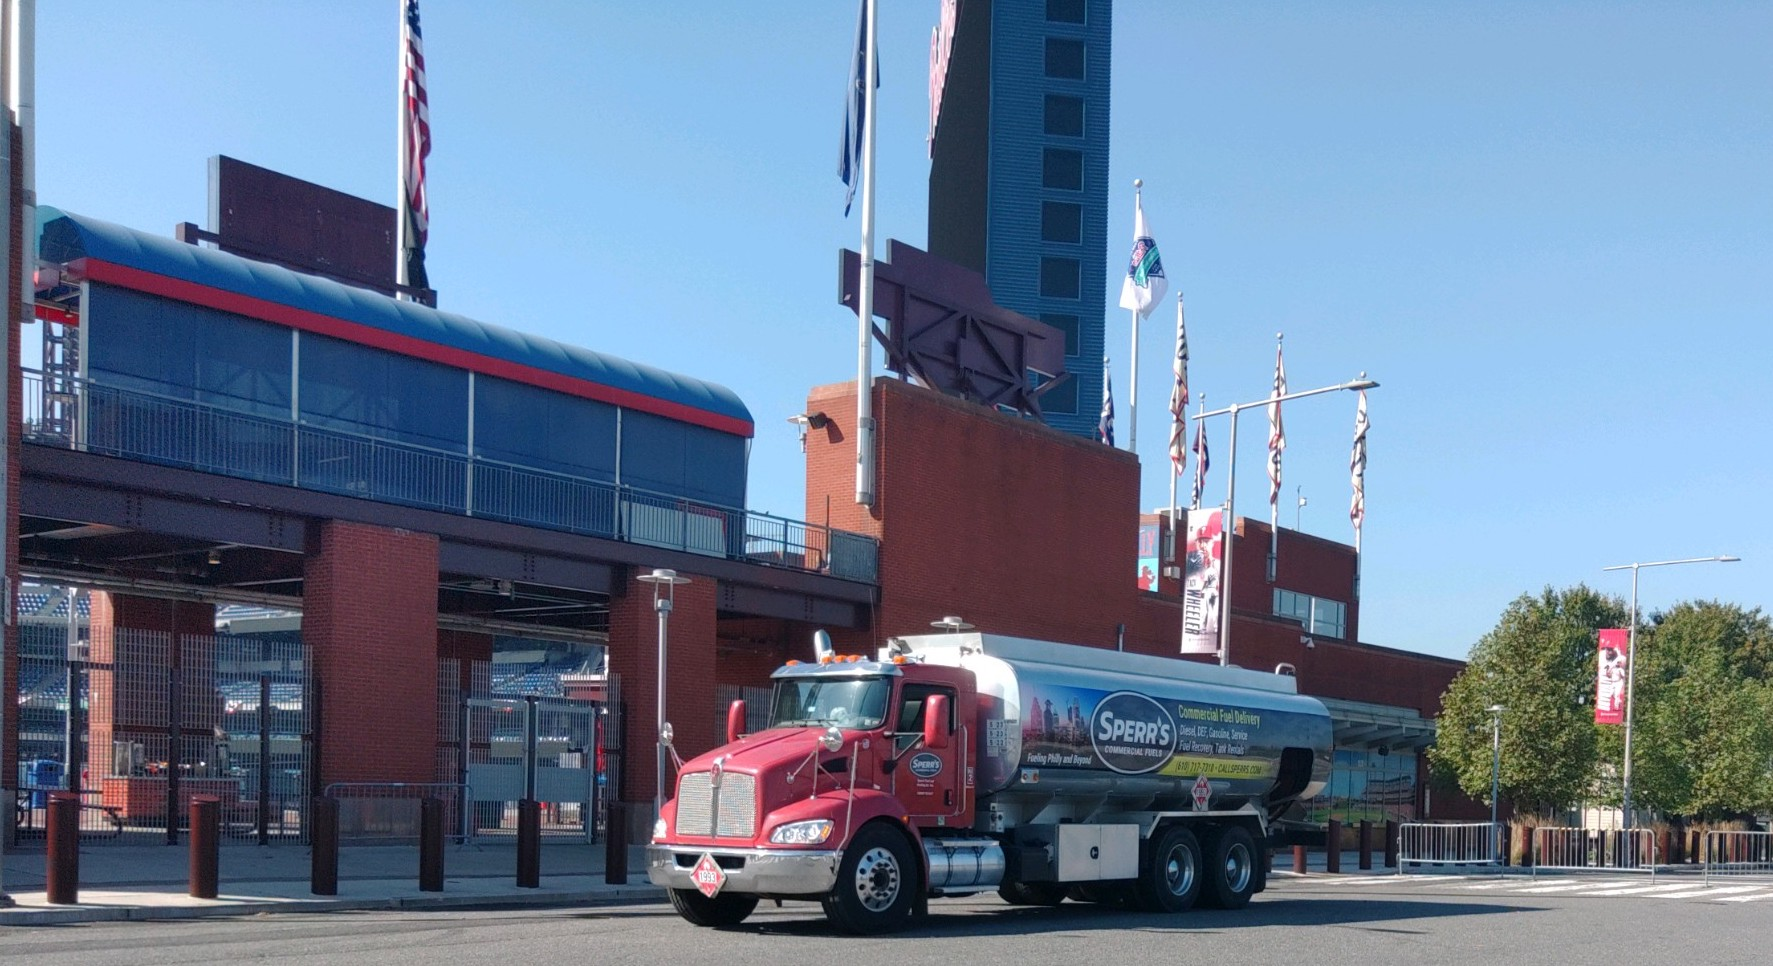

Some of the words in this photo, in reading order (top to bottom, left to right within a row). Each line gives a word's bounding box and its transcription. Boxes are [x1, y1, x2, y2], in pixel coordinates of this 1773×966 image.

[1185, 590, 1201, 635] WHEELER
[1178, 704, 1219, 722] Commercial
[1220, 710, 1234, 724] Fuel
[1235, 711, 1260, 729] Delivery
[1098, 711, 1170, 746] SPERR'S
[1180, 725, 1196, 738] Diesel,
[1197, 726, 1208, 738] DEF,
[1209, 727, 1230, 740] Gasoline,
[1231, 729, 1248, 741] Service
[1105, 745, 1143, 757] COMMERCIAL
[1145, 748, 1163, 758] FUELS
[1179, 740, 1192, 752] Fuel
[1192, 741, 1213, 755] Recovery,
[1215, 743, 1227, 754] Tank
[1227, 744, 1245, 756] Rentals
[1027, 752, 1047, 765] Fueling
[1047, 753, 1062, 766] Philly
[1062, 754, 1073, 764] and
[1073, 755, 1092, 767] Beyond
[1175, 761, 1189, 773] (610)
[699, 872, 716, 882] 1993
